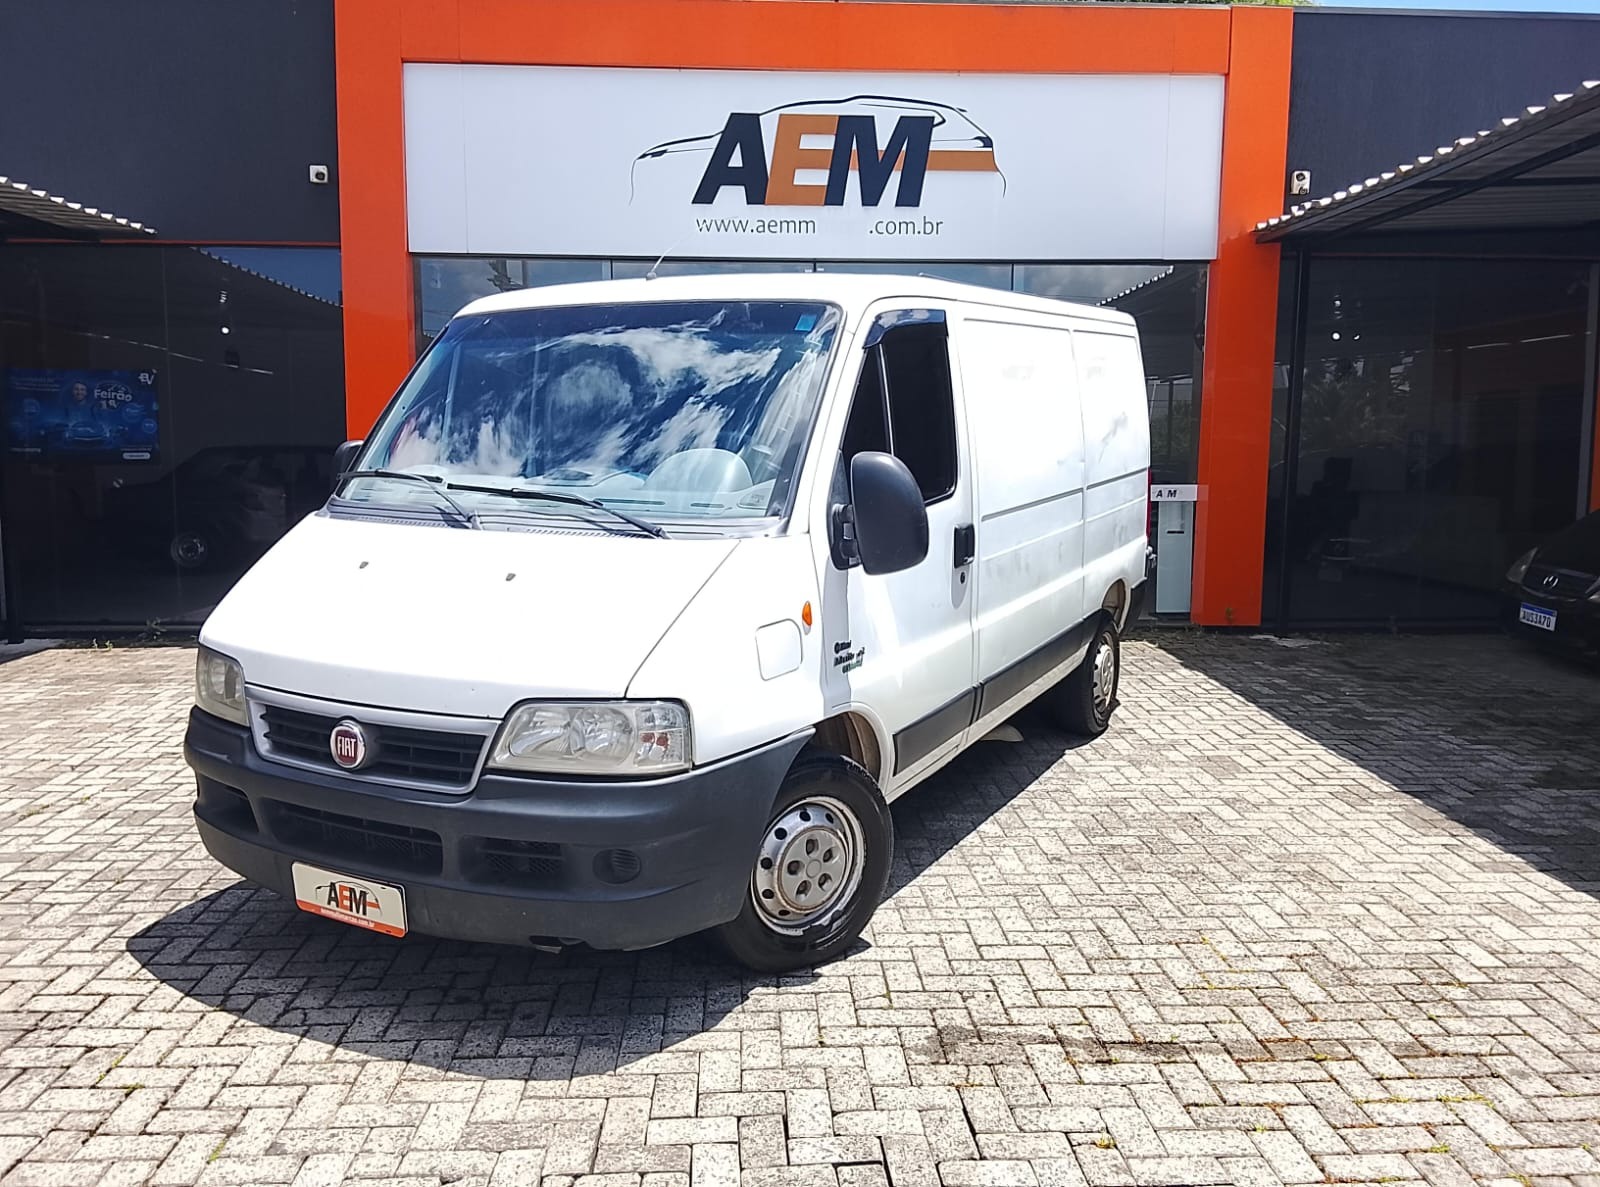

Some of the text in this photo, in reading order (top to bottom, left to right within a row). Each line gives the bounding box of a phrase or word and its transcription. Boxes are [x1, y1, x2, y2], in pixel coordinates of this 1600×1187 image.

[691, 112, 935, 207] AEM
[696, 216, 943, 235] www.aemm .com.br
[94, 388, 133, 402] Feirão
[337, 735, 357, 758] FIAT
[327, 881, 368, 916] AEM
